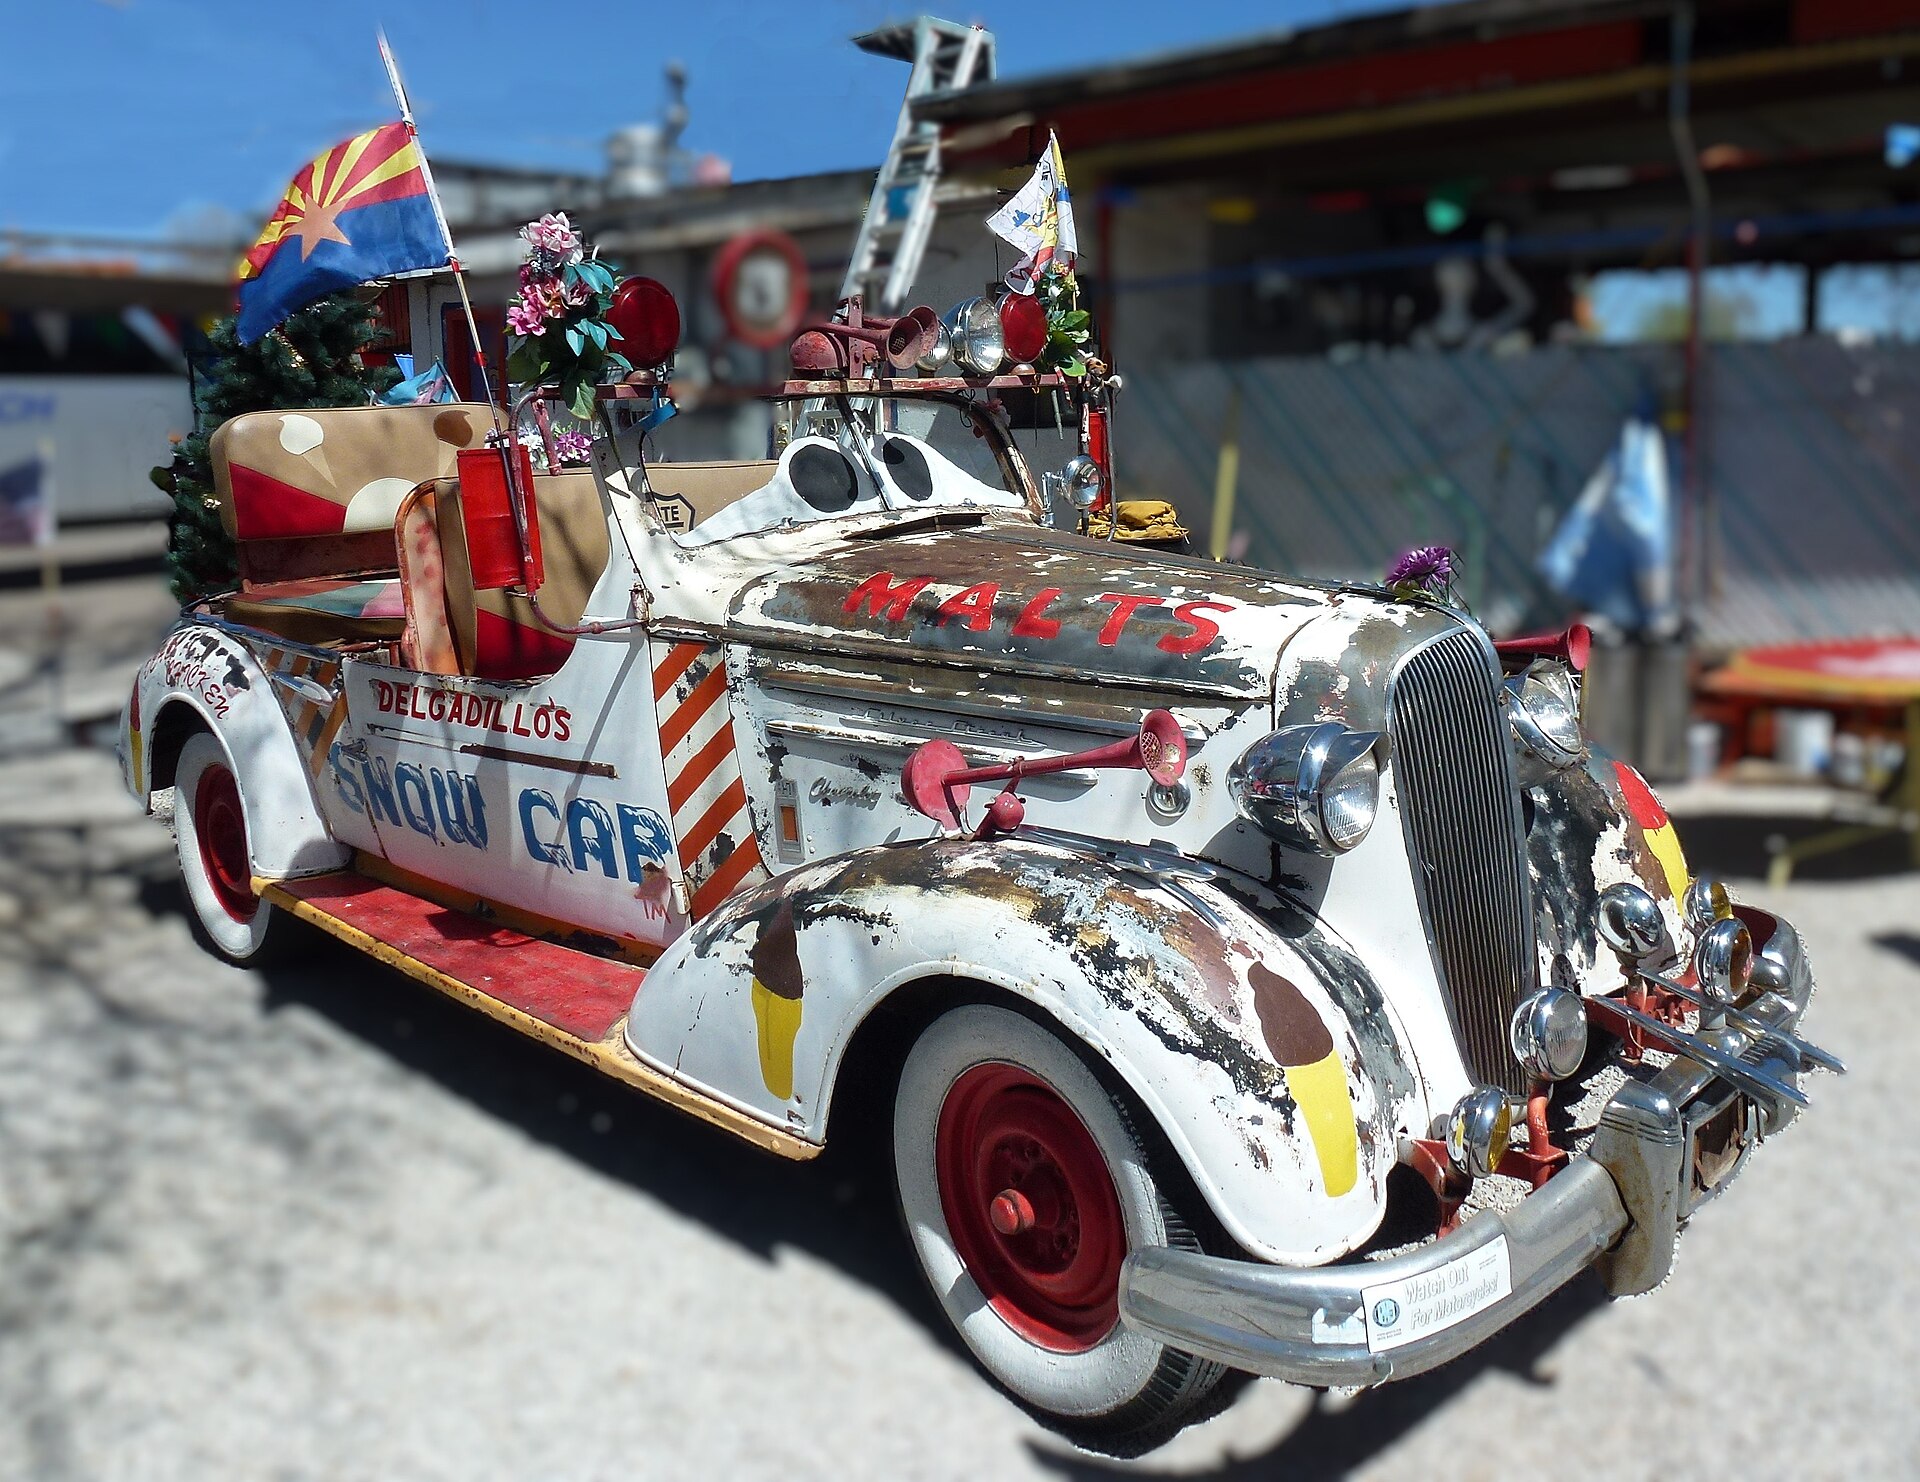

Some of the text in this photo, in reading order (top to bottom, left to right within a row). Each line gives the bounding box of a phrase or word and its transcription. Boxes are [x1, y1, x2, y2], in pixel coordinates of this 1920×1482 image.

[842, 571, 1235, 655] MALTS
[329, 740, 674, 886] SNOW CAP
[1404, 1273, 1445, 1304] Watch
[1448, 1262, 1470, 1288] Out
[1410, 1309, 1433, 1330] For
[1435, 1273, 1498, 1321] Motorcycles!
